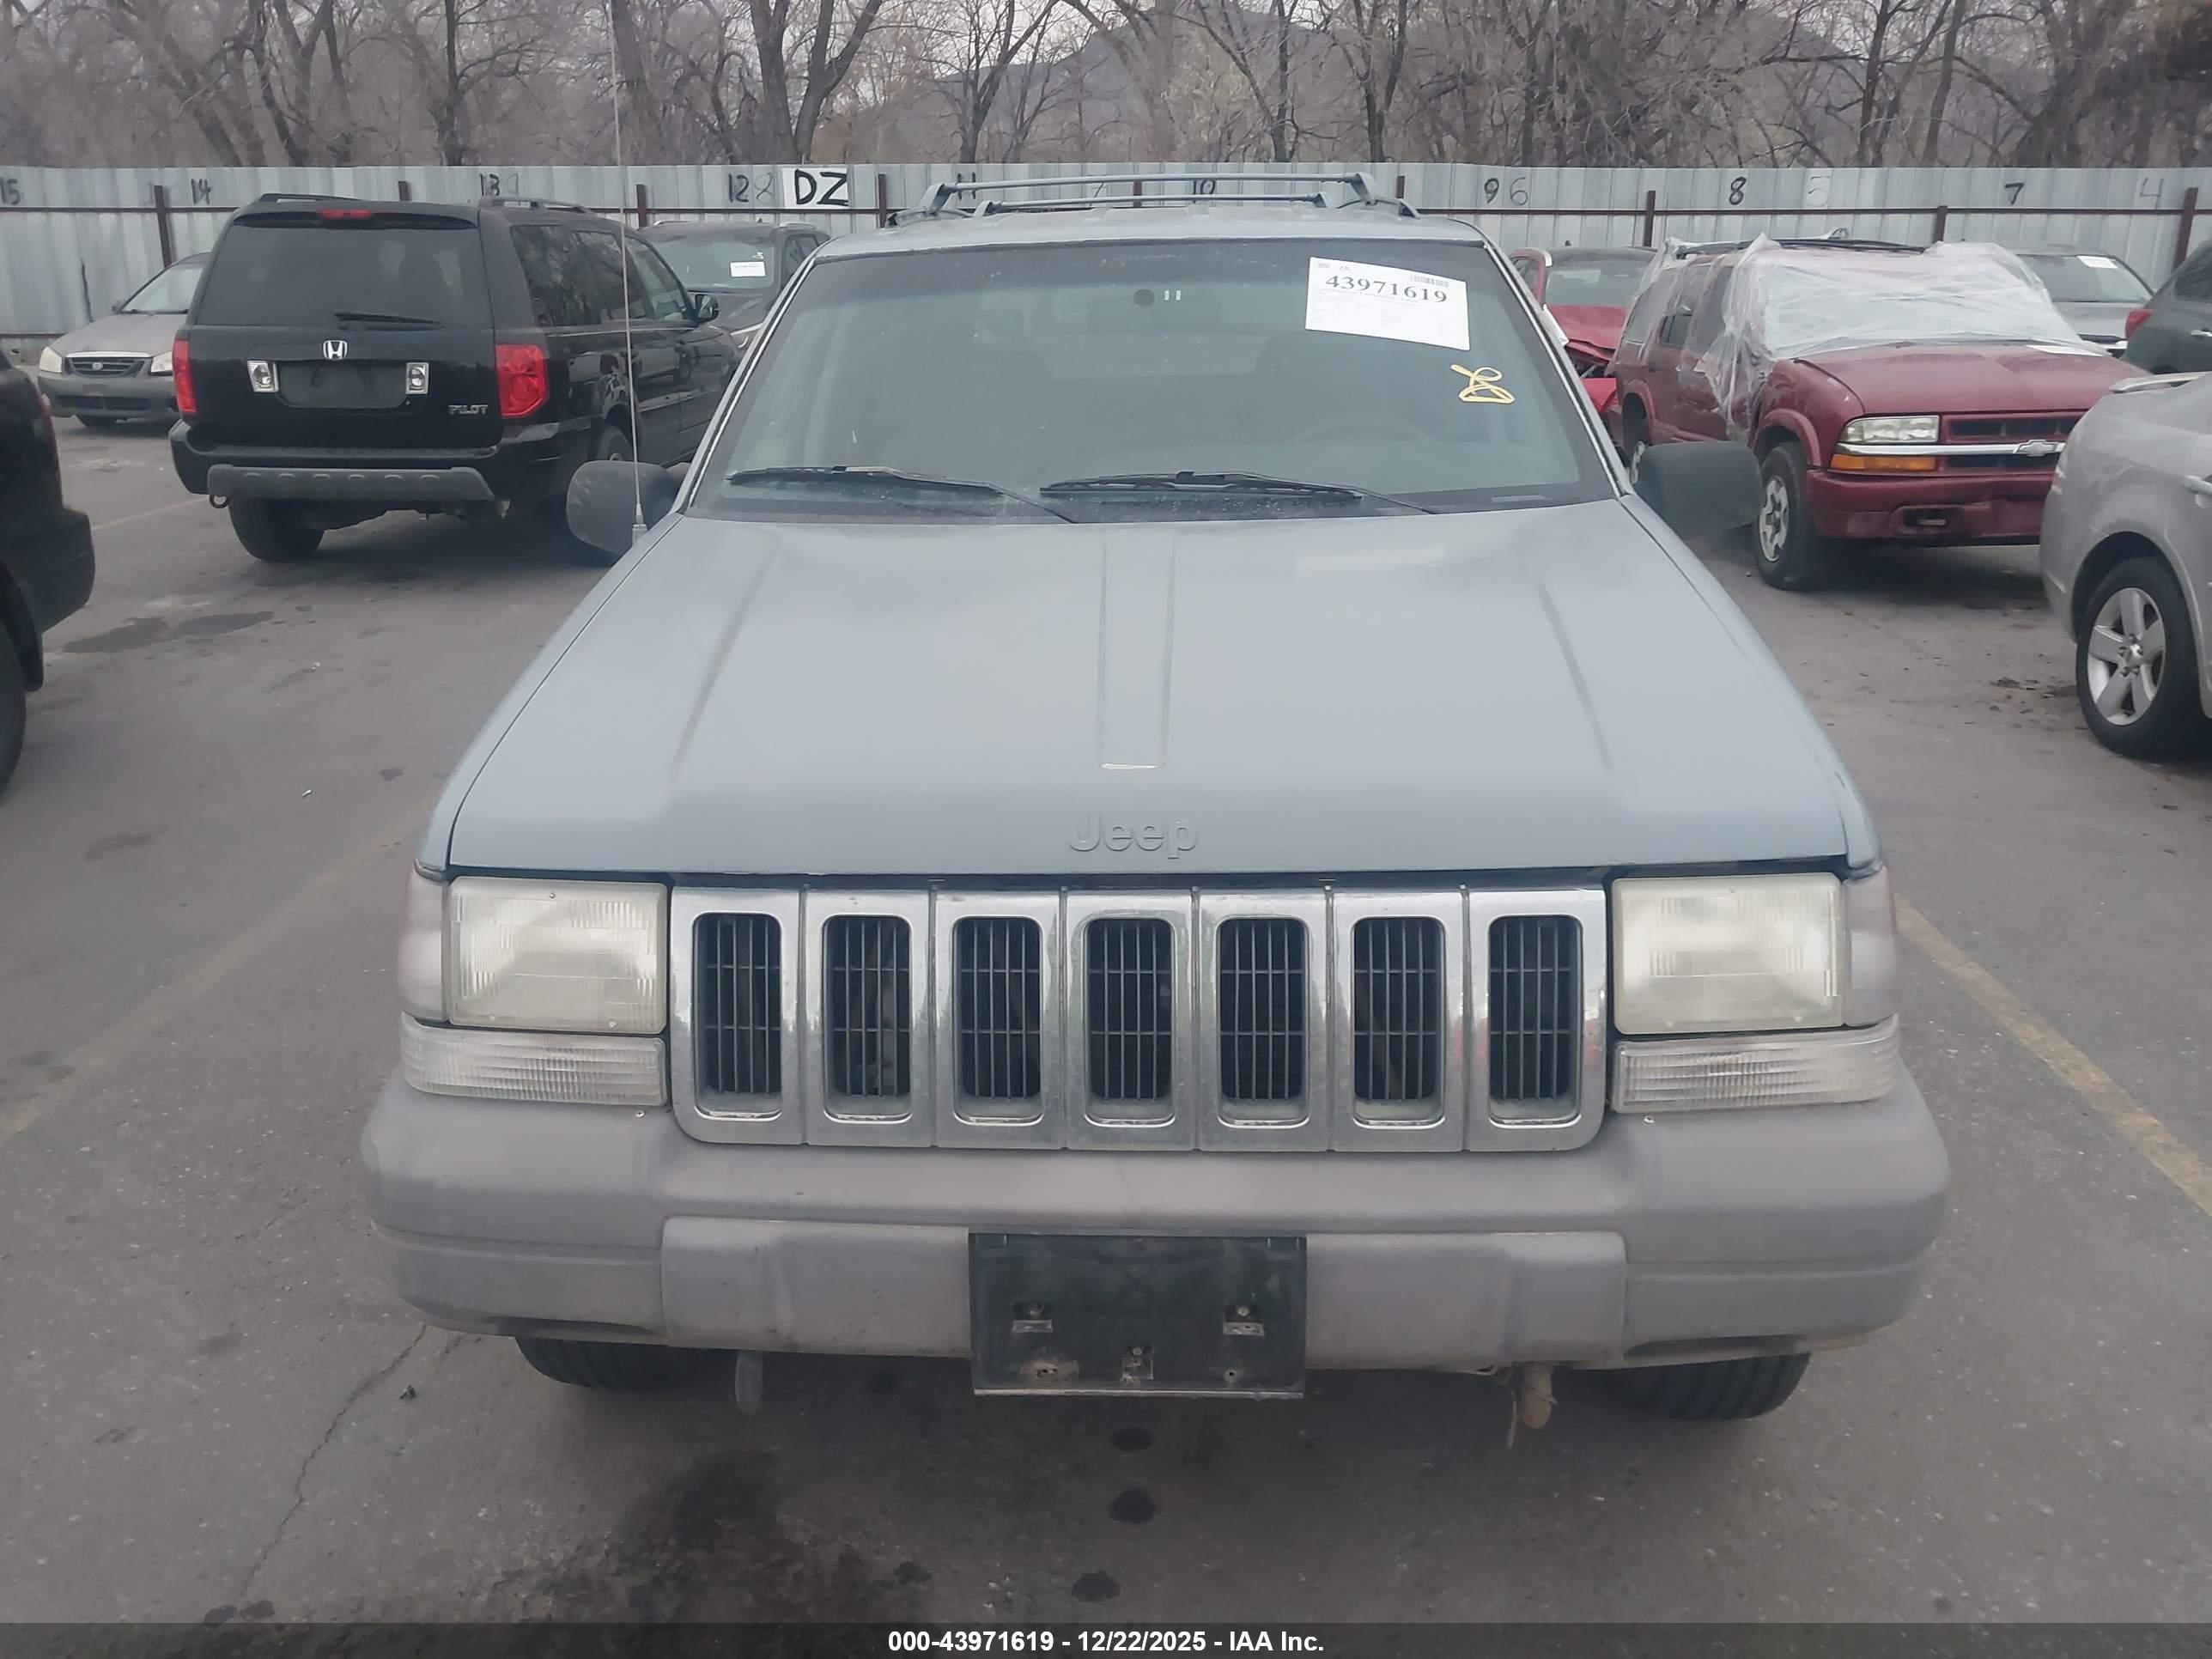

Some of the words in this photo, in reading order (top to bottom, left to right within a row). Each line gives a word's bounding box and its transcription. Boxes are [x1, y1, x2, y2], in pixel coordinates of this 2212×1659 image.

[0, 177, 21, 205] 15
[191, 179, 211, 205] 14
[480, 173, 500, 196] 13
[728, 173, 749, 203] 12
[794, 168, 849, 206] DZ
[1729, 176, 1747, 205] 8
[2004, 182, 2025, 205] 7
[2140, 177, 2164, 210] 4
[1326, 274, 1448, 303] 43971619
[1069, 811, 1200, 860] Jeep
